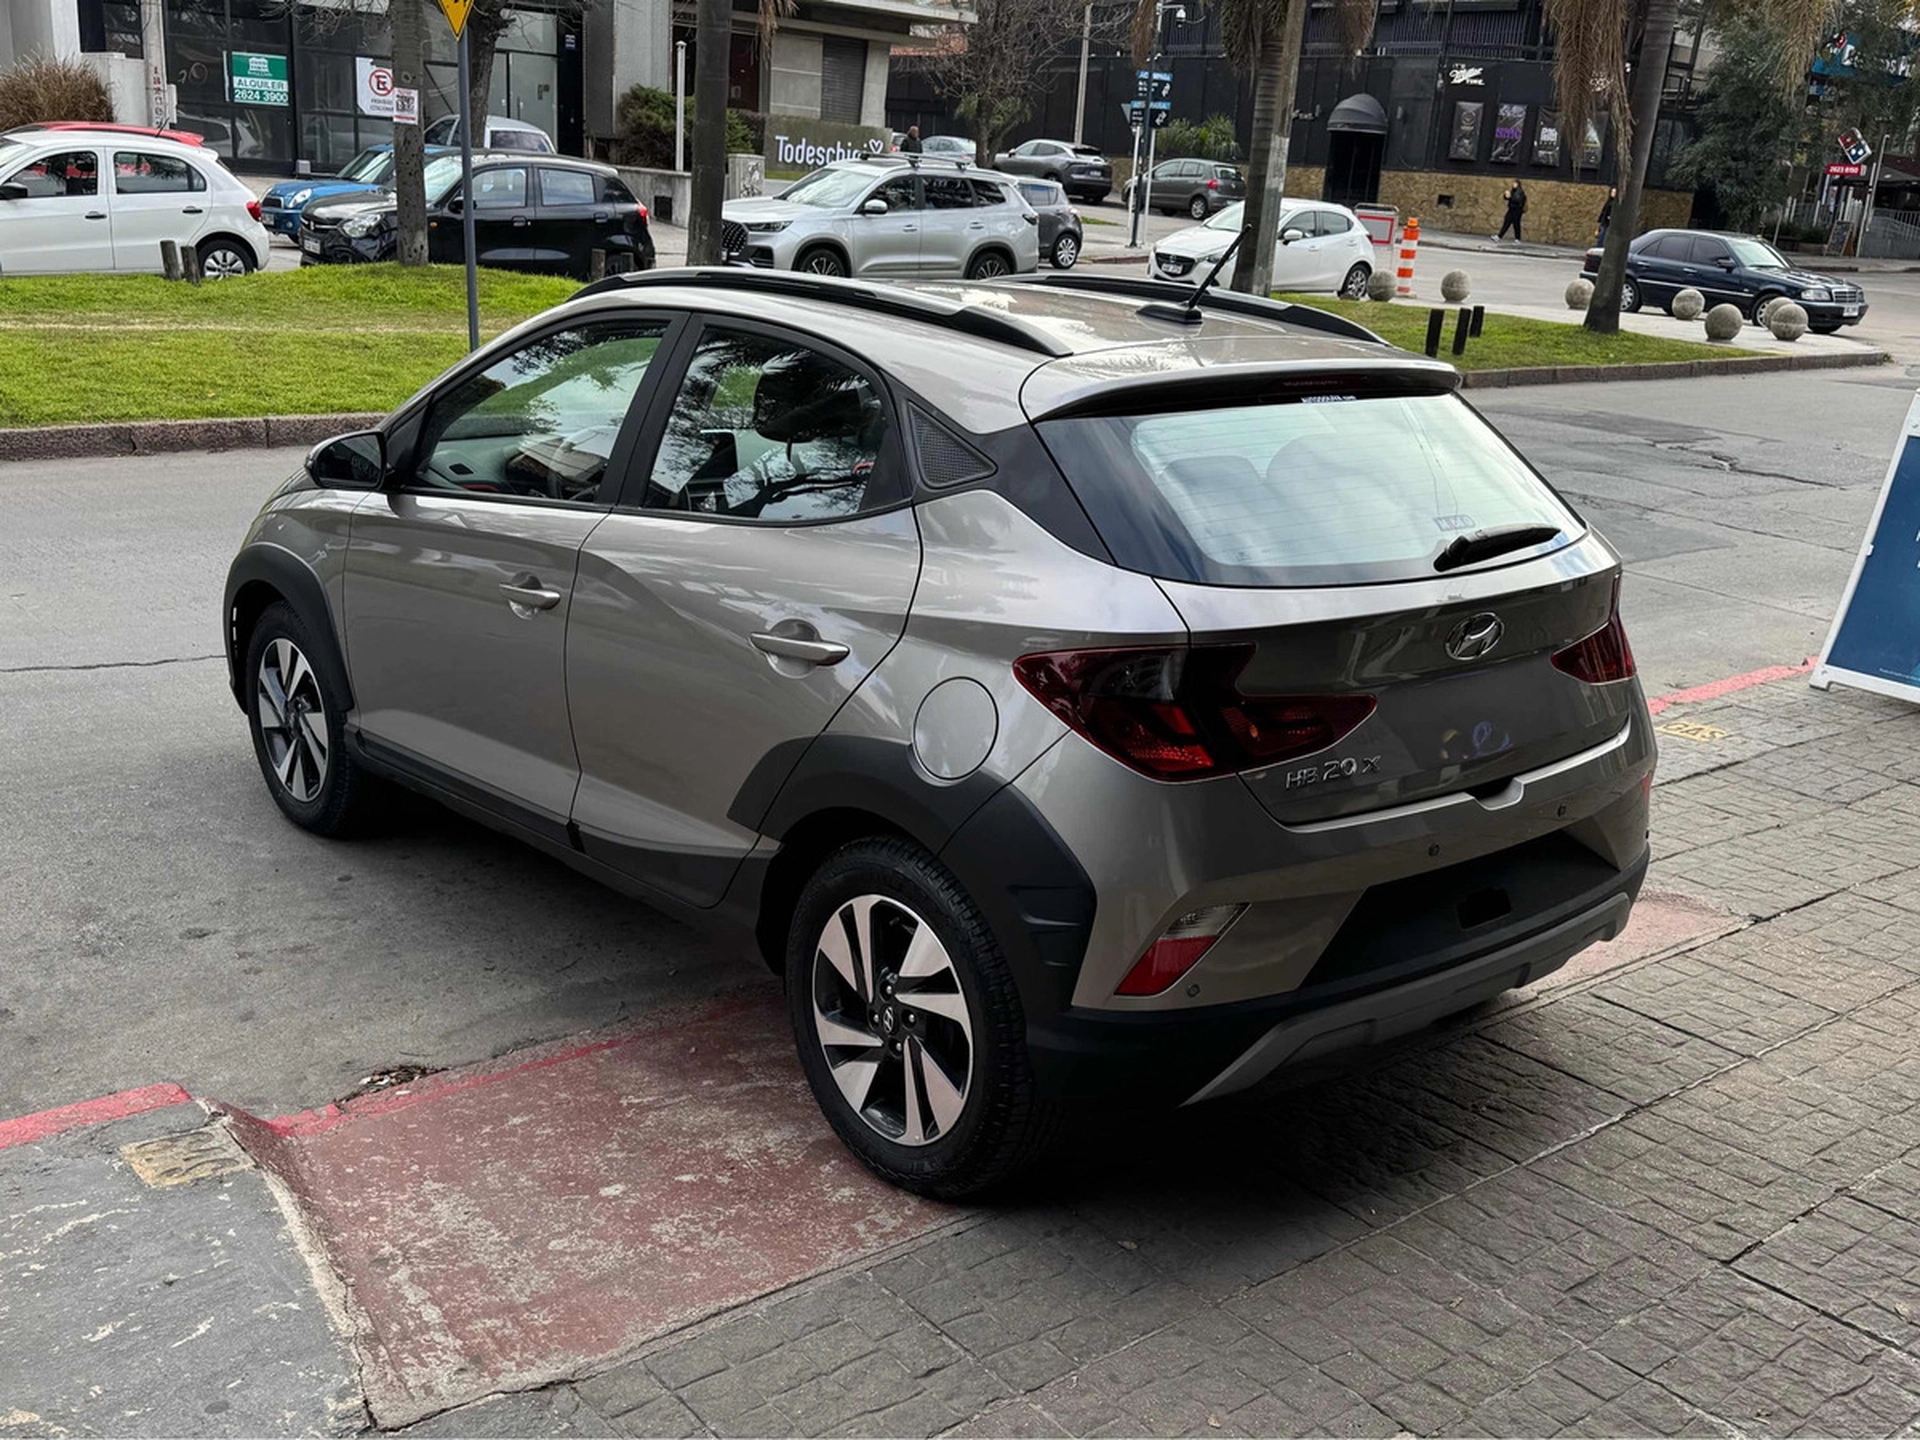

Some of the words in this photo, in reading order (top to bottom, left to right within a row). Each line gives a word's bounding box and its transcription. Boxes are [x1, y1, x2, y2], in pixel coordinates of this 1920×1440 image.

[237, 79, 285, 90] ALQUILER
[234, 89, 260, 100] 2624
[263, 91, 288, 103] 3900
[775, 135, 868, 166] Todeschin
[1662, 722, 1726, 740] GAS
